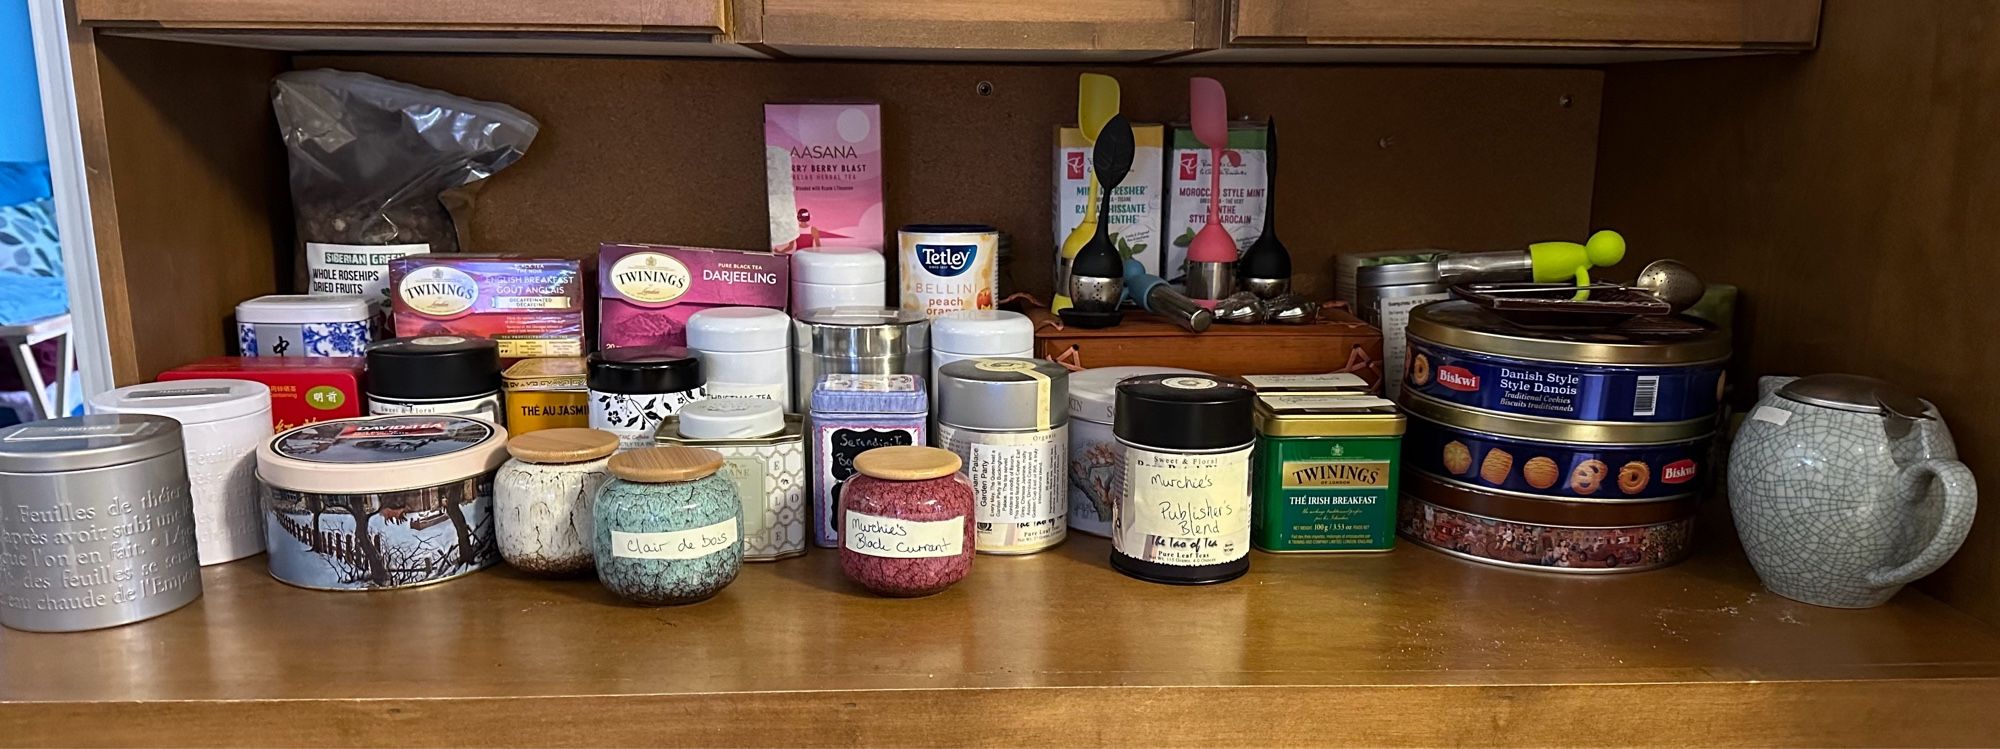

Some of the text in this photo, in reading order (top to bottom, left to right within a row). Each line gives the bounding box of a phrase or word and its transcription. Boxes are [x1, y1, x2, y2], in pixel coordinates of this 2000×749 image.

[811, 164, 838, 173] BERRY
[841, 164, 867, 173] BLAST
[1222, 189, 1244, 198] STYLE
[1246, 189, 1265, 198] MINT
[326, 253, 367, 264] SIBERIAN
[922, 248, 970, 270] Tetley
[312, 268, 379, 281] WHOLE ROSEHIPS
[486, 276, 575, 285] ENGLISH BREAKFAST
[616, 270, 686, 289] TWININGS
[703, 269, 777, 285] DARJEELING
[313, 281, 363, 294] DRIED FRUITS
[405, 283, 474, 300] TWININGS
[525, 286, 565, 295] ANGLAIS
[915, 283, 977, 294] BELLINI
[928, 297, 964, 307] peach
[1440, 370, 1477, 388] Biskwi
[1501, 368, 1579, 385] Danish Style
[1500, 379, 1577, 396] Style Danois
[1500, 398, 1574, 412] Biscuits traditionnels
[1504, 391, 1571, 405] Traditional Cookies
[542, 406, 556, 416] AU
[557, 405, 588, 416] JASMI
[1033, 432, 1057, 442] Organic
[971, 448, 979, 473] Palace
[1154, 455, 1218, 465] Sweet & Floral
[1292, 464, 1379, 485] TWININGS
[1665, 465, 1697, 480] Biskwi
[980, 459, 989, 507] Garden Party
[1151, 473, 1214, 489] Murchie's
[1289, 493, 1378, 505] THÉ IRISH BREAKFAST
[17, 502, 96, 524] Feuilles
[107, 496, 132, 517] de
[1159, 498, 1233, 522] Publisher's
[53, 524, 108, 544] avoir
[112, 514, 151, 539] subi
[851, 517, 907, 536] Murchie's
[1178, 520, 1220, 536] Blend
[627, 538, 671, 555] Clair
[677, 538, 697, 553] de
[855, 532, 952, 553] Black Currant
[1152, 535, 1166, 547] The
[1169, 537, 1187, 548] Tao
[1189, 538, 1201, 553] of
[1204, 538, 1218, 548] Tea
[77, 550, 103, 566] en
[1158, 550, 1210, 559] Pure Leaf Teas
[23, 573, 51, 590] des
[62, 564, 133, 589] feuilles
[141, 560, 159, 576] se
[36, 589, 107, 611] chaude
[112, 584, 137, 603] de
